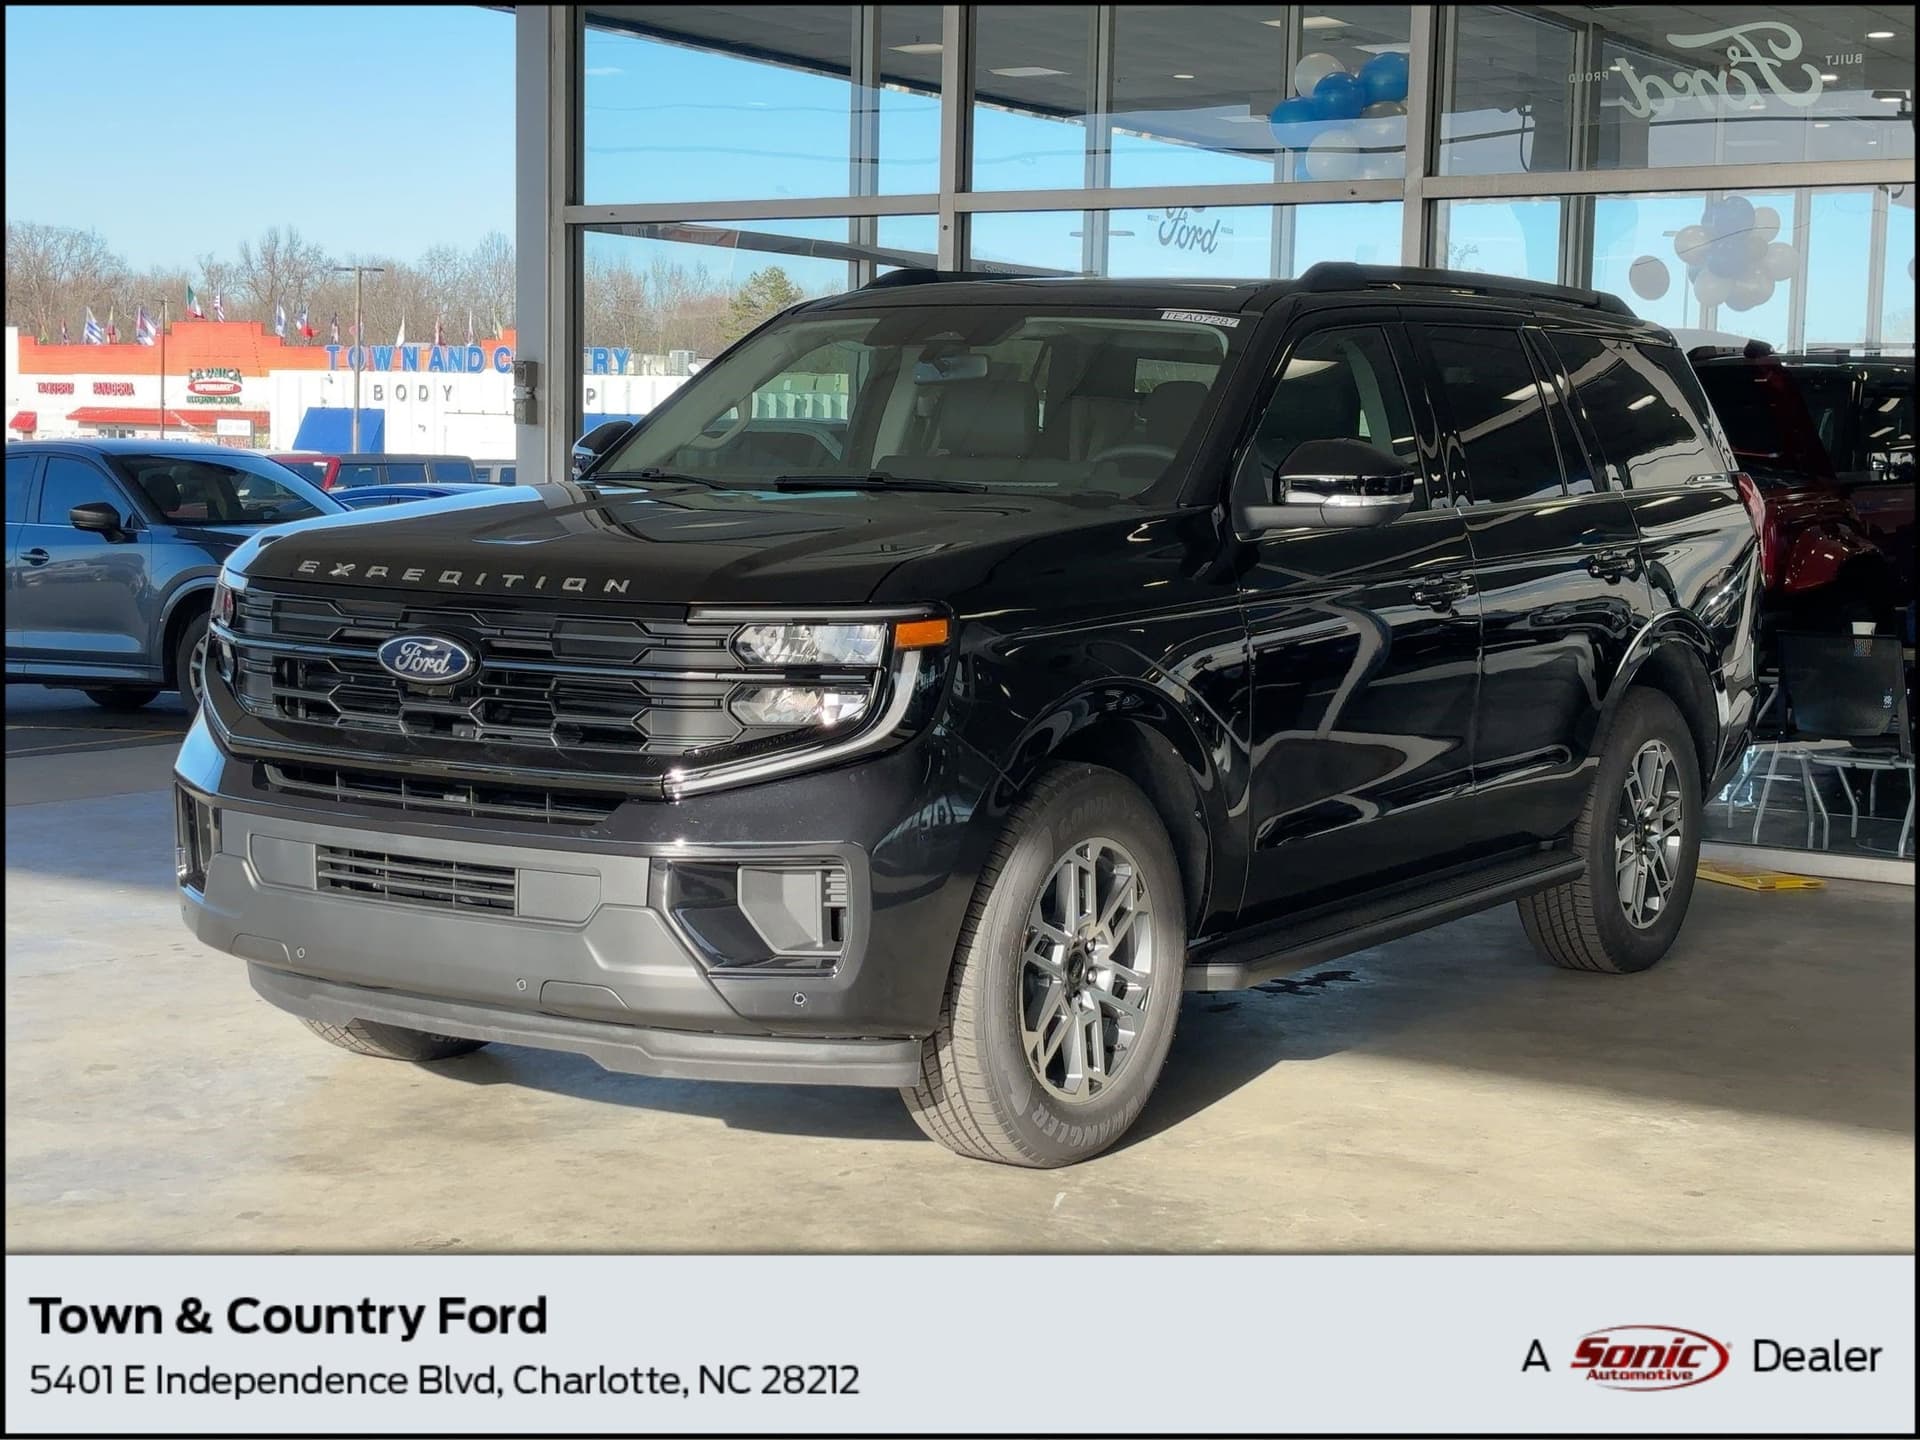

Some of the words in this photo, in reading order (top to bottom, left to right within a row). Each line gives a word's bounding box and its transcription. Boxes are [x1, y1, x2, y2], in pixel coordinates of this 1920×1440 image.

[325, 345, 419, 373] TOWN
[428, 345, 487, 373] AND
[373, 384, 453, 402] BODY
[298, 560, 631, 593] EXPEDITION
[394, 641, 452, 674] Ford
